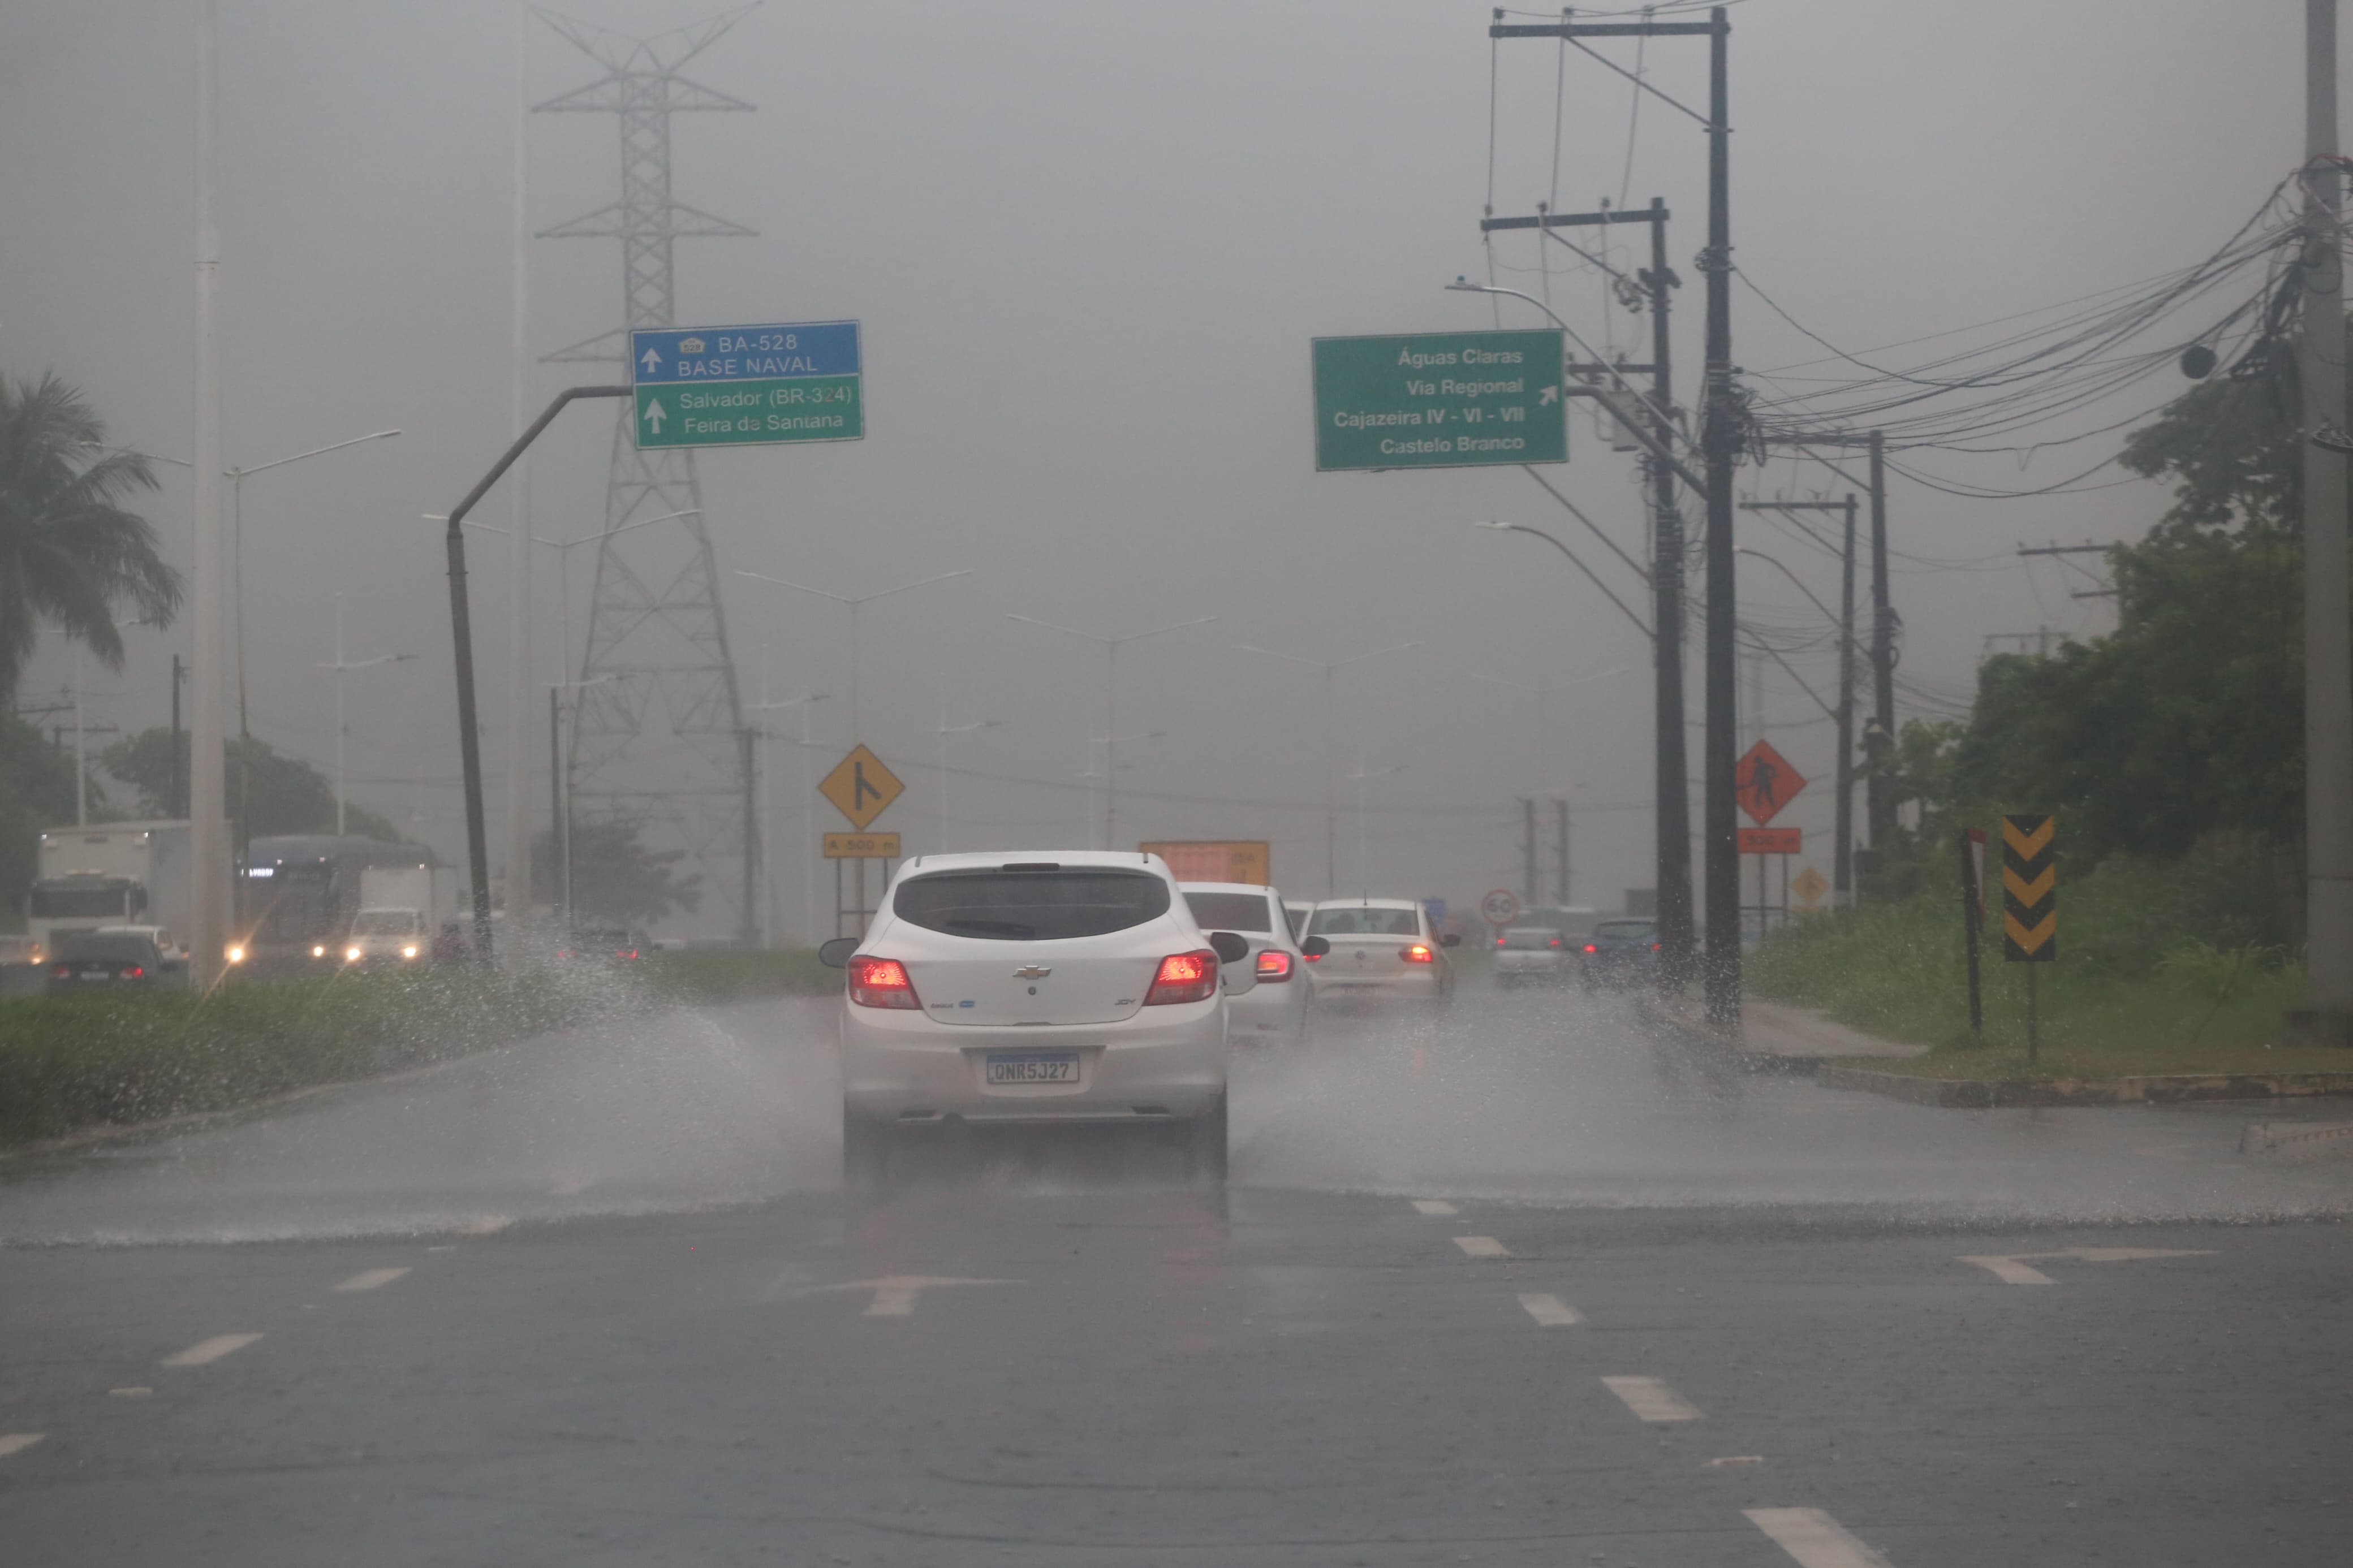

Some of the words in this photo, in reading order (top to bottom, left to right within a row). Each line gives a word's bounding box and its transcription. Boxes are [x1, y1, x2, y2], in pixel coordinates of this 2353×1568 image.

[719, 334, 798, 353] BA-528
[679, 360, 738, 377] BASE
[746, 356, 817, 373] NAVAL
[1398, 347, 1457, 369] Águas
[1462, 348, 1523, 364] Claras
[680, 391, 762, 409] Salvador
[769, 385, 852, 407] (BR-324)
[1407, 380, 1436, 395] Via
[1441, 378, 1523, 397] Regional
[684, 417, 732, 433] Feira
[738, 416, 761, 430] de
[768, 414, 843, 431] Santana
[1334, 411, 1421, 429] Cajazeira
[1427, 409, 1445, 424] IV
[1463, 408, 1482, 423] VI
[1500, 407, 1525, 422] VII
[1380, 437, 1451, 454] Castelo
[1457, 435, 1525, 452] Branco
[1488, 898, 1512, 913] 60
[996, 1063, 1068, 1080] QNR5J27
